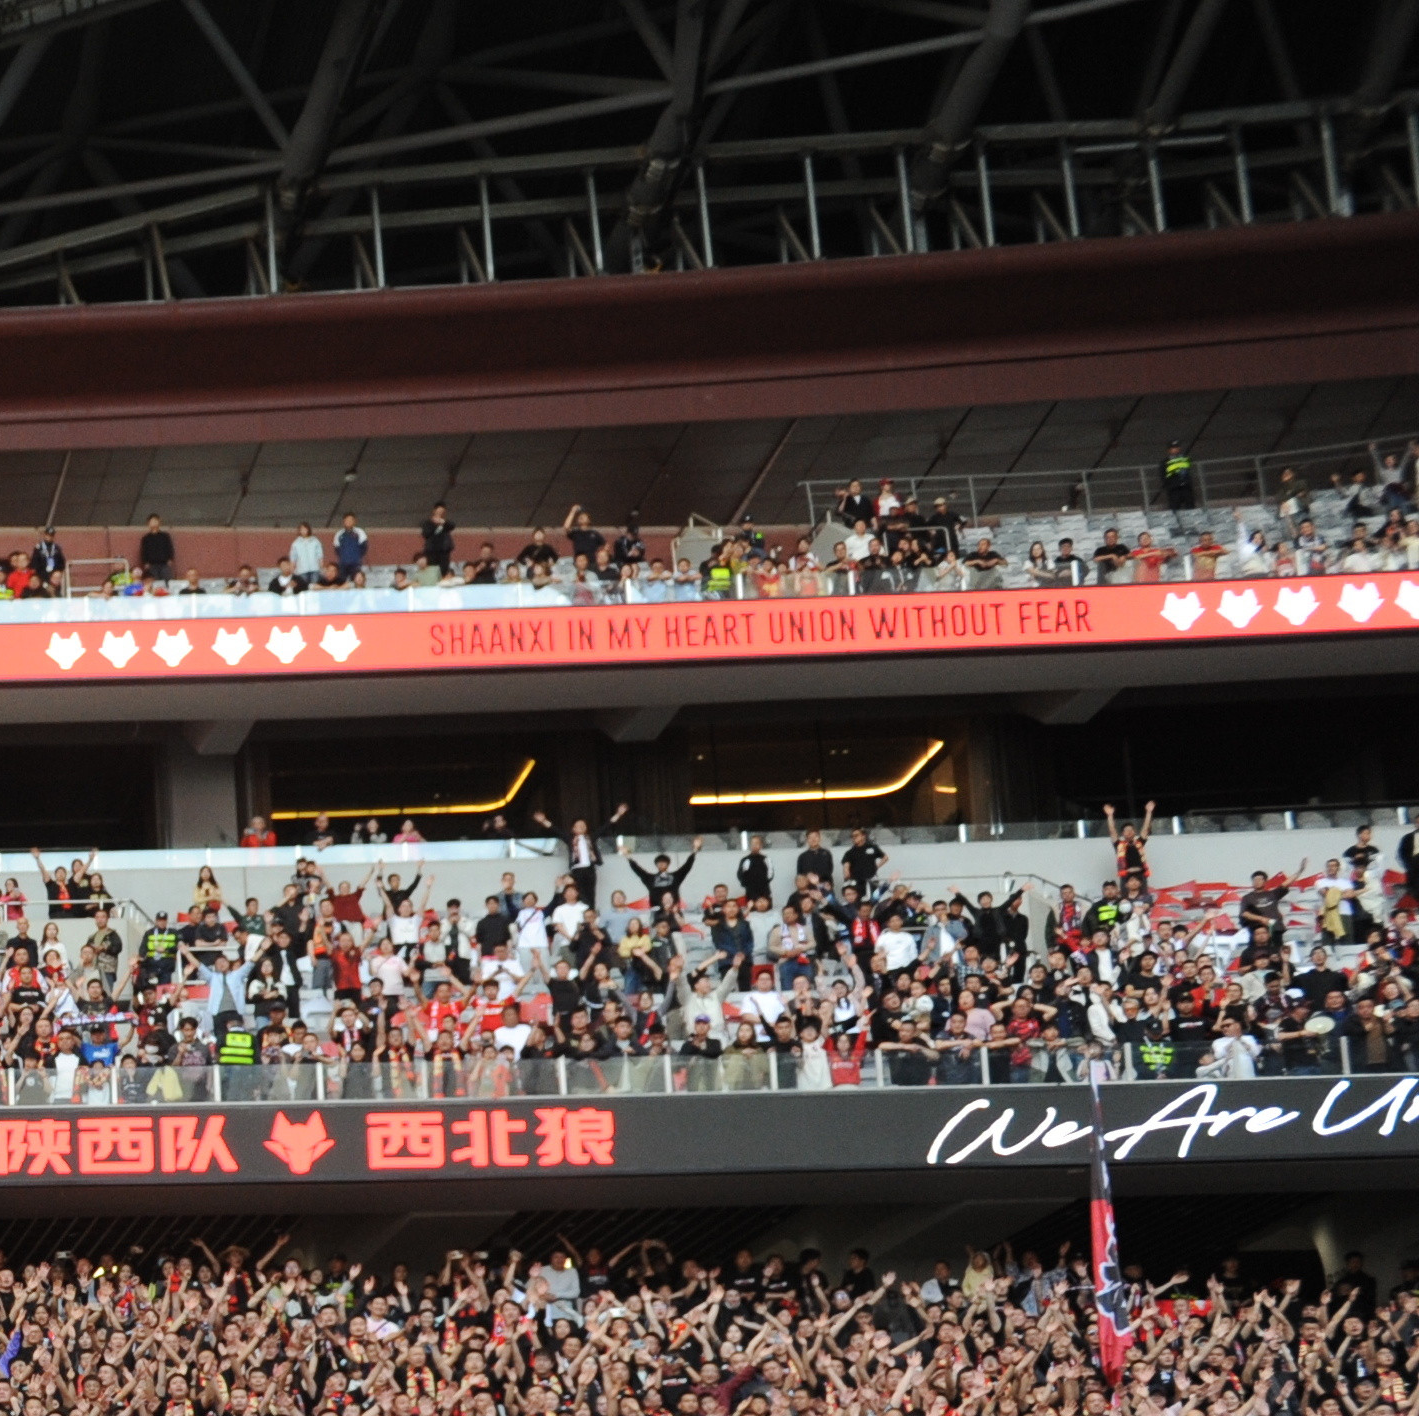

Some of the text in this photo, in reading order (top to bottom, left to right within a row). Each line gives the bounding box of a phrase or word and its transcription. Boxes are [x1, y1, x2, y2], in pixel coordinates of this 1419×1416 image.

[428, 599, 1094, 657] SHAANXI IN MY HEART UNION WITHOUT FEAR
[366, 1106, 616, 1171] 西北狼
[926, 1076, 1419, 1165] We Are U
